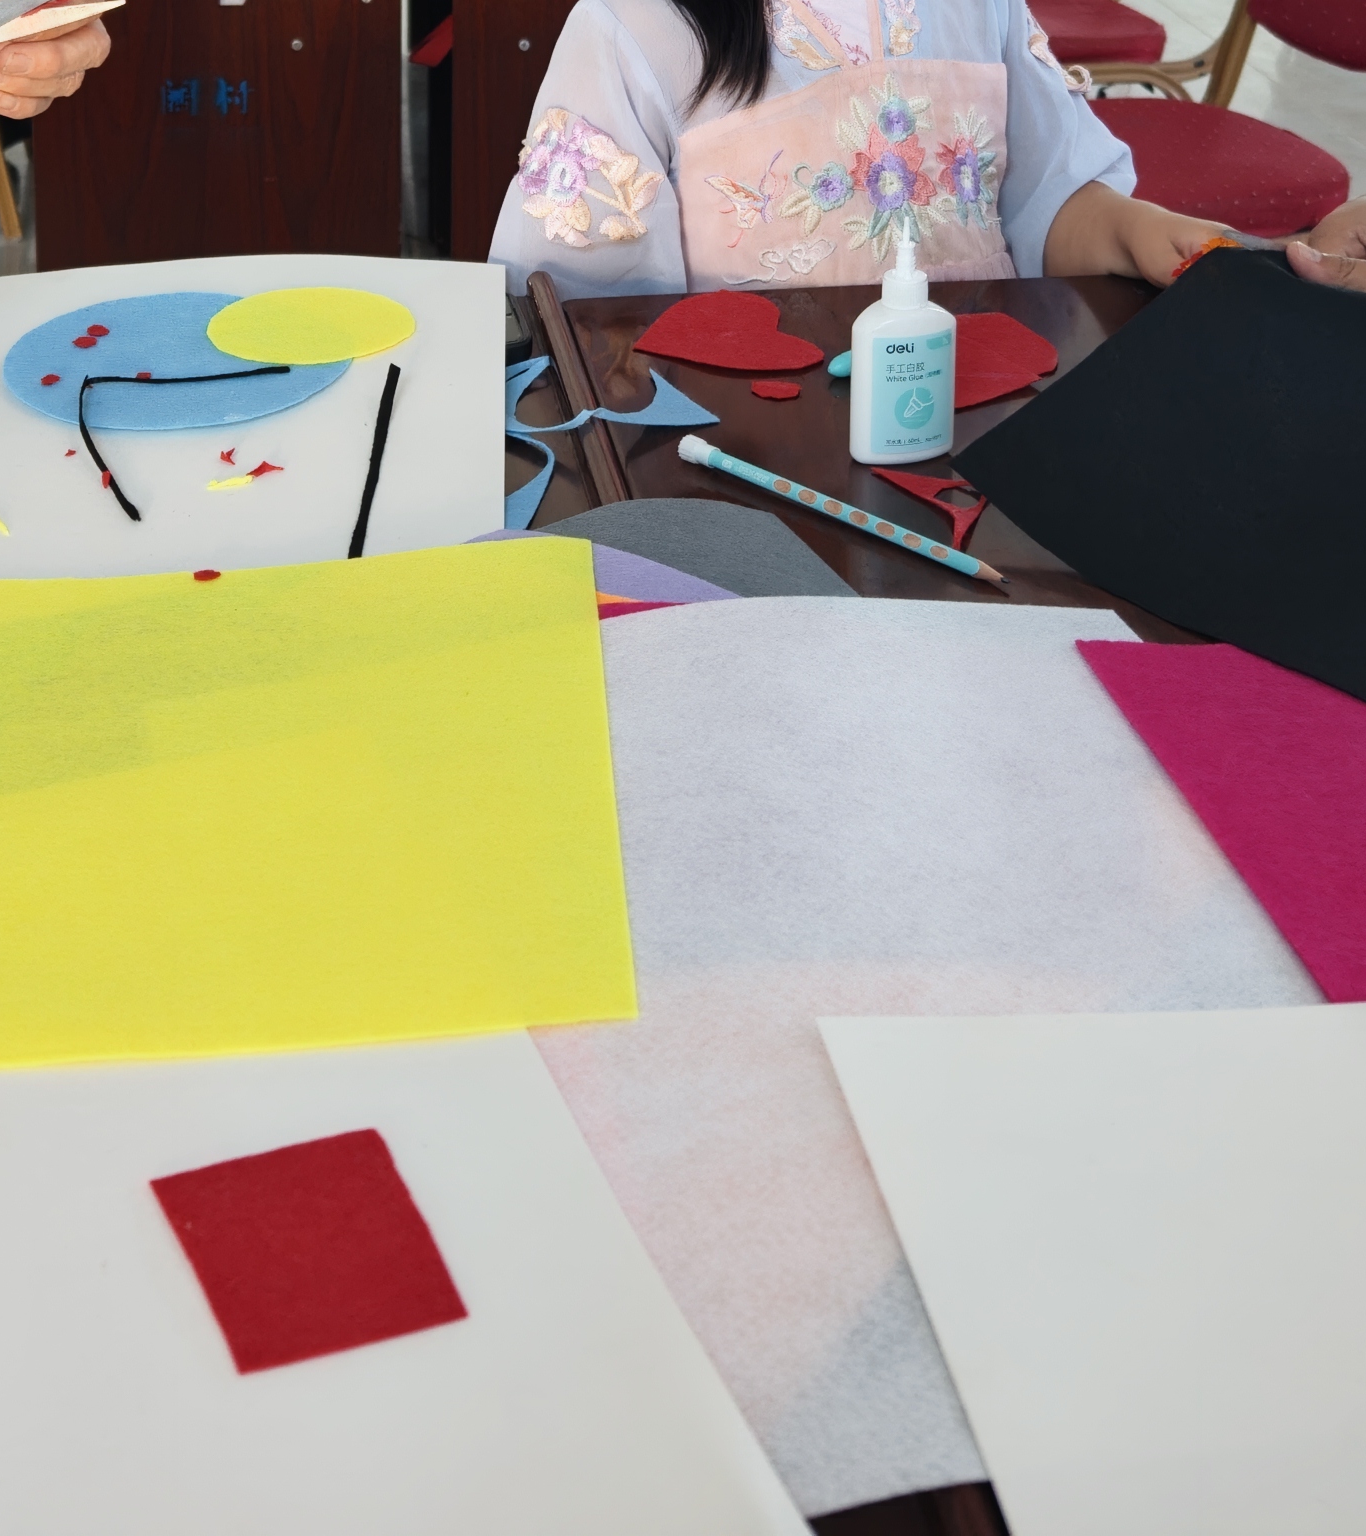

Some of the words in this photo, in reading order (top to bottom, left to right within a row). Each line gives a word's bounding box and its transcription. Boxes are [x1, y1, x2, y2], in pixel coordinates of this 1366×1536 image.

[886, 342, 915, 354] deli
[886, 362, 926, 374] 手工白胶
[886, 375, 907, 383] White
[909, 373, 924, 381] Glue
